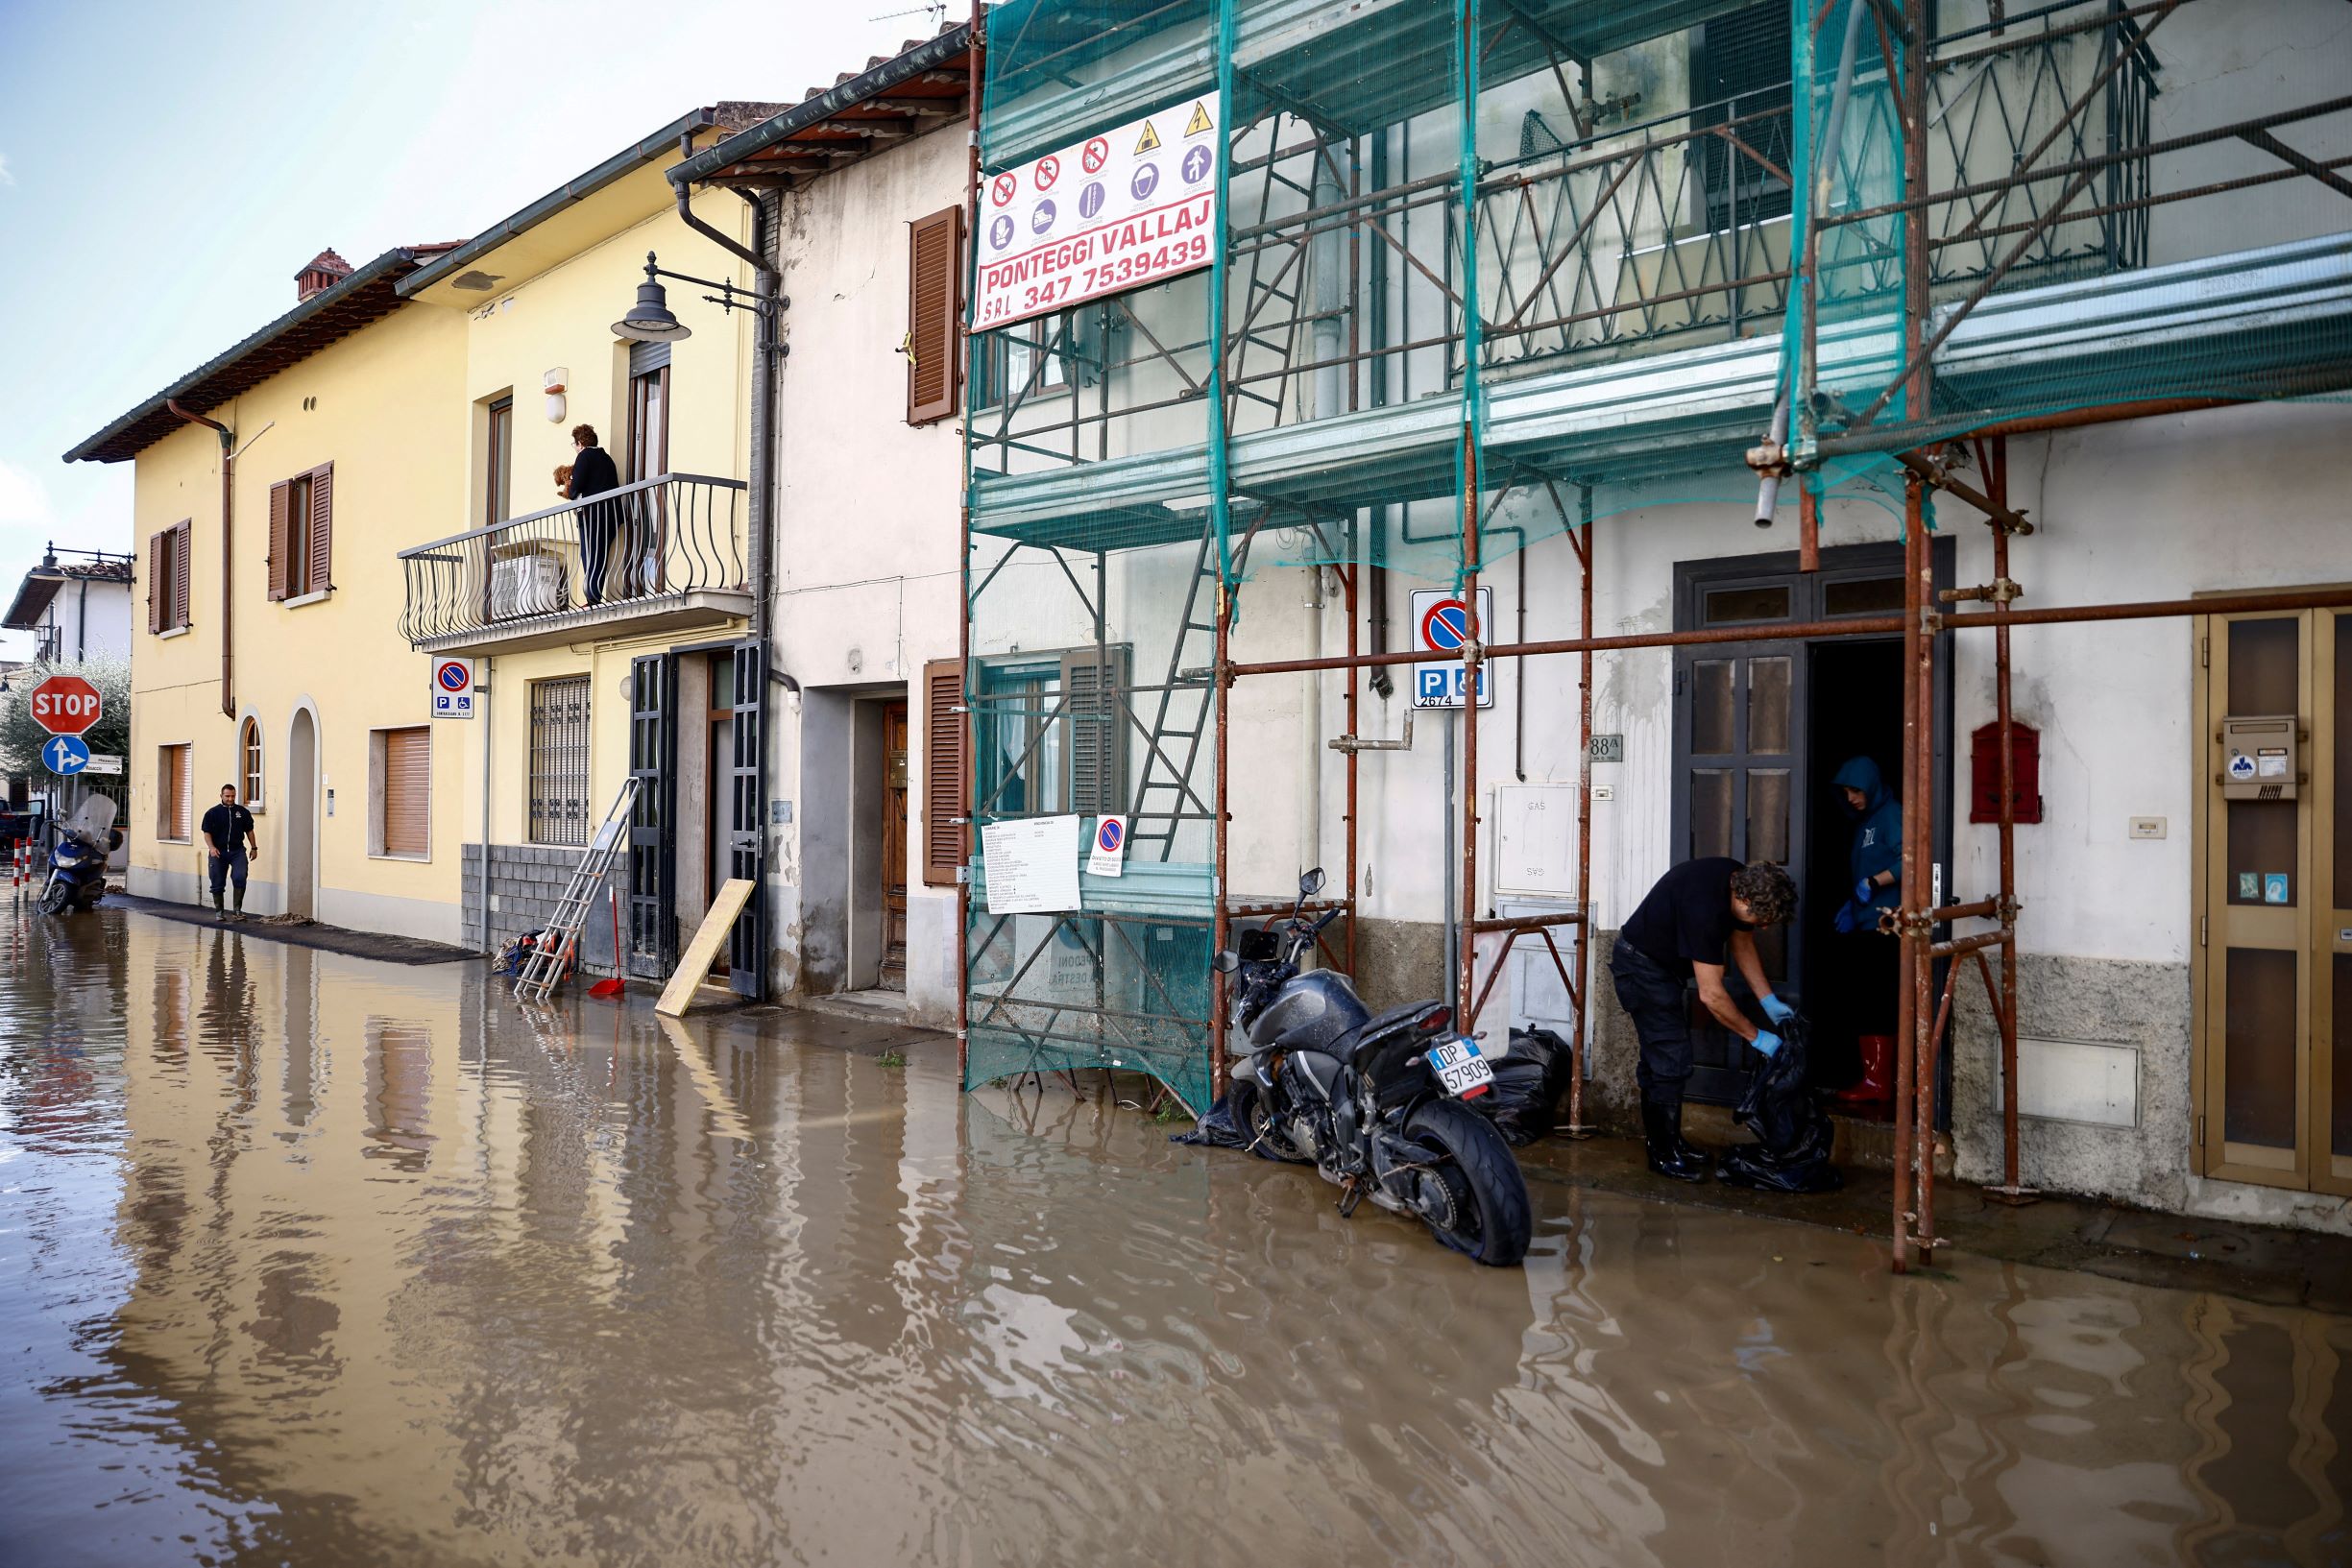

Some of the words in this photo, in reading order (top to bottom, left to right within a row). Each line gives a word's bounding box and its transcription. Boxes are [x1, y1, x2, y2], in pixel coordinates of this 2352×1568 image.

[986, 236, 1094, 295] PONTEGGI
[1102, 199, 1211, 255] VALLAJ
[983, 294, 1011, 322] SRL
[1024, 276, 1072, 310] 347
[1082, 234, 1207, 293] 7539439
[1425, 673, 1442, 693] P
[36, 693, 98, 716] STOP
[439, 698, 448, 707] P
[1420, 695, 1453, 707] 2674
[1527, 802, 1545, 810] GAS
[1439, 1045, 1458, 1065] DP
[1444, 1059, 1491, 1089] 57909
